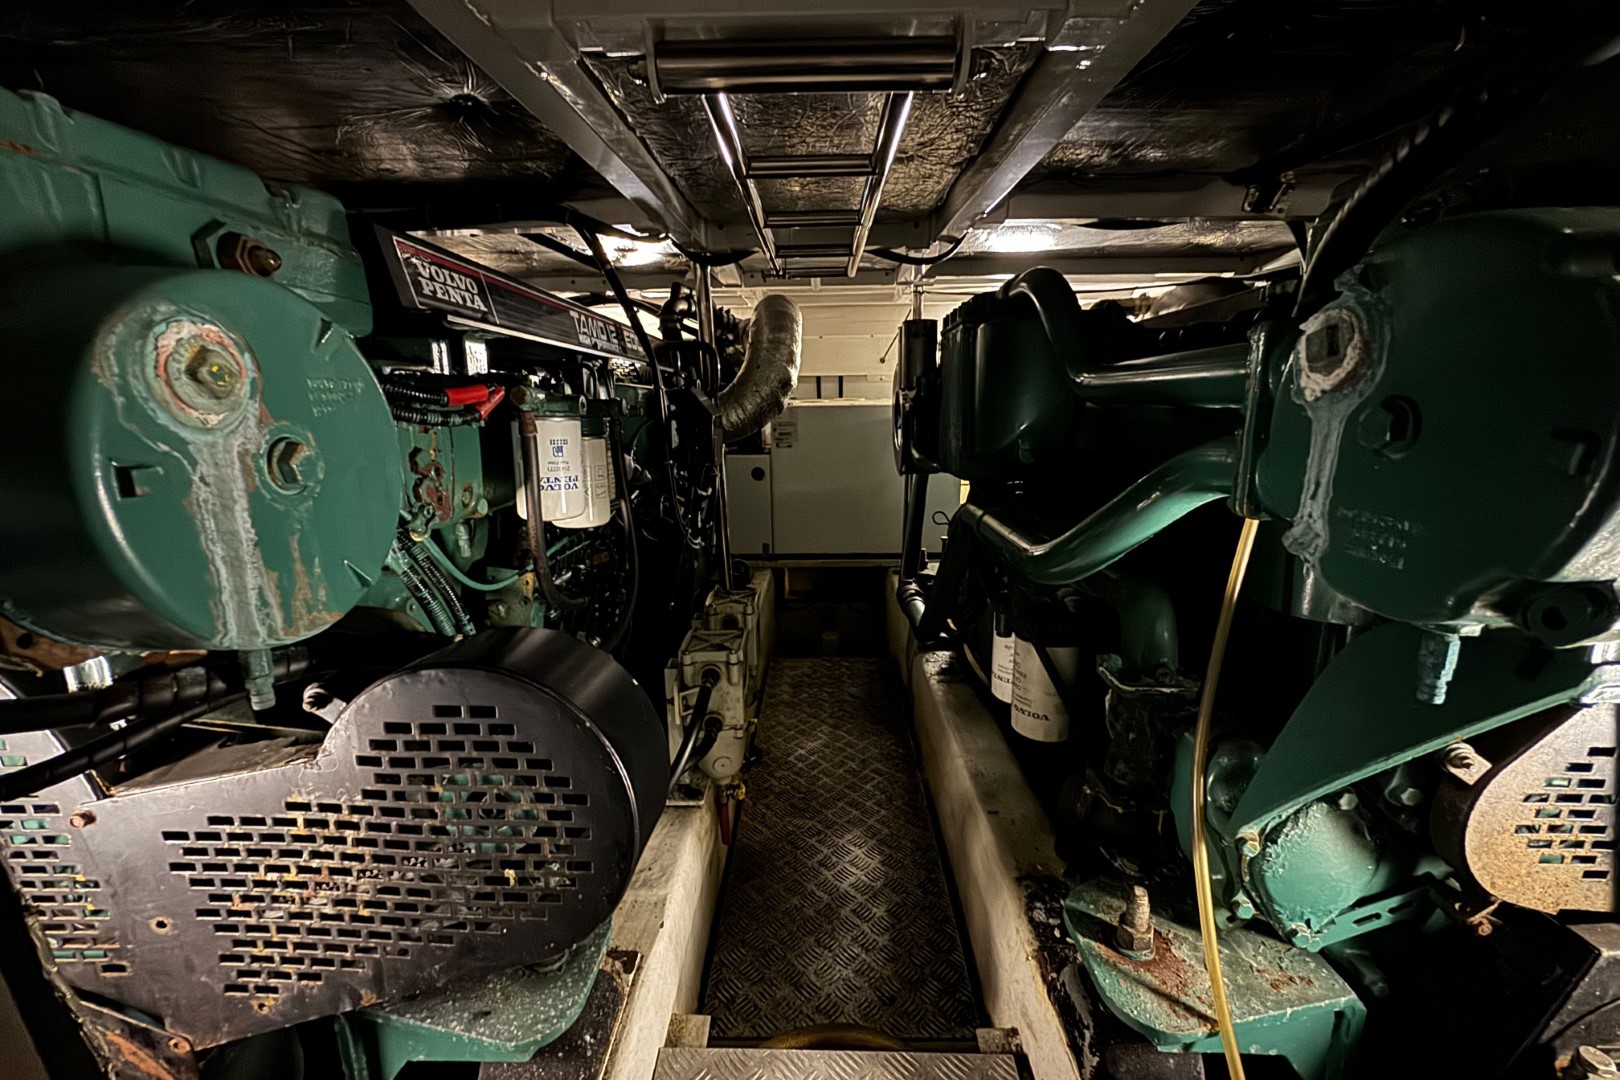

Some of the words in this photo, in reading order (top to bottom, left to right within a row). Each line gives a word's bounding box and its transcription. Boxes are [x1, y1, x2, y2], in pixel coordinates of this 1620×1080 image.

[415, 258, 478, 295] VOLVO
[418, 276, 488, 312] PENTA
[1013, 704, 1051, 722] VOLVO
